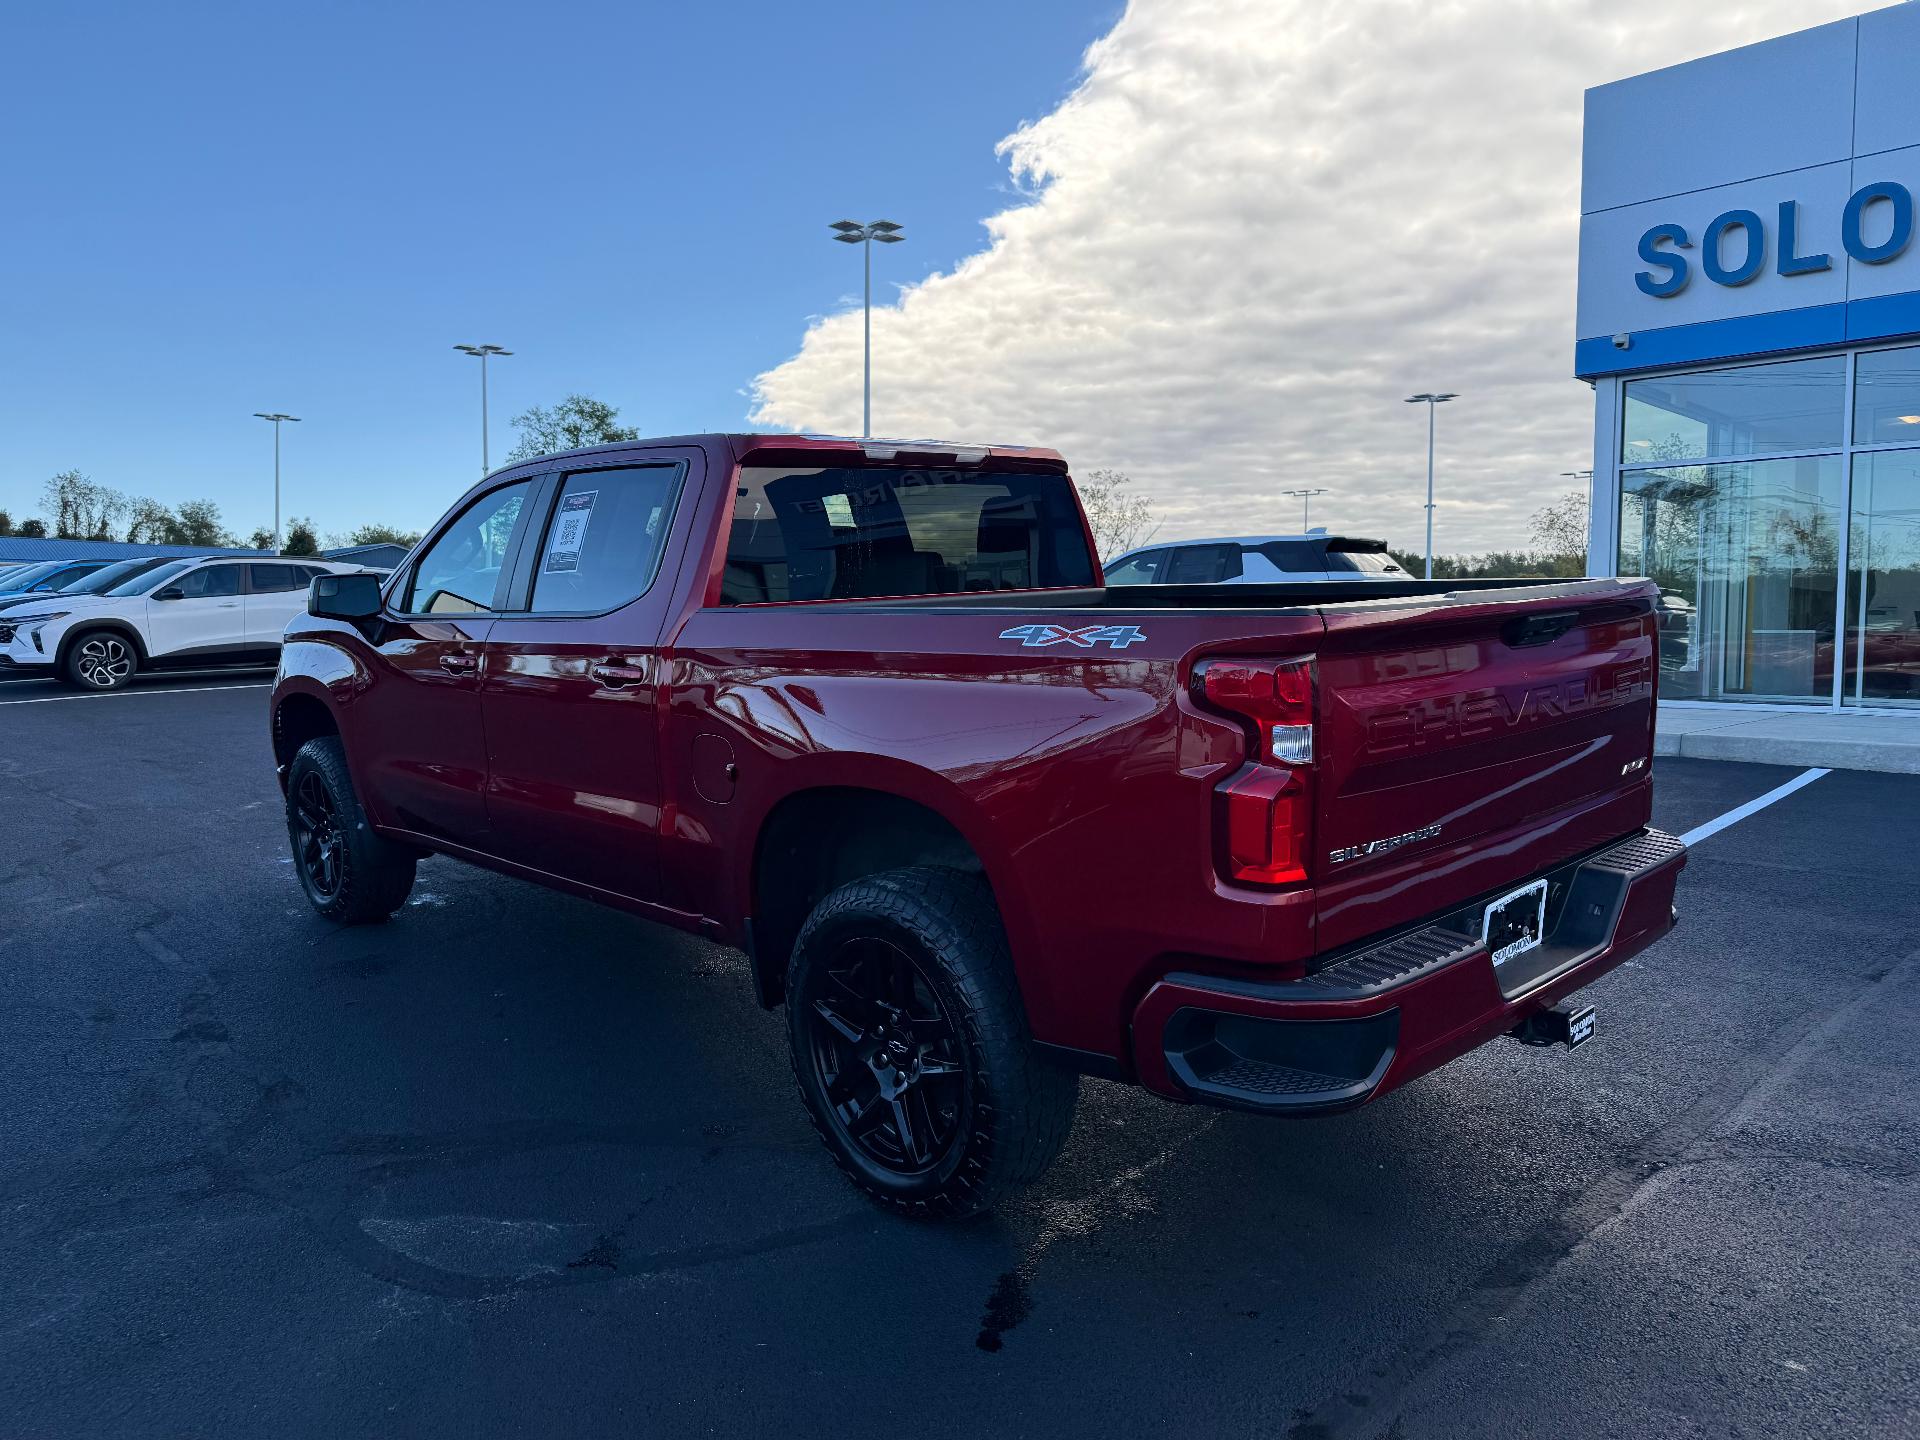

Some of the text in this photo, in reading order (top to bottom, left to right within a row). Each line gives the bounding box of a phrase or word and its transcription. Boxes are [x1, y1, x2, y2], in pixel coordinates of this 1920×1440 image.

[1635, 181, 1914, 298] SOLO
[1367, 665, 1650, 754] CHEVROLET
[1329, 824, 1442, 864] SILVERADO
[1493, 935, 1532, 962] SOLOMON
